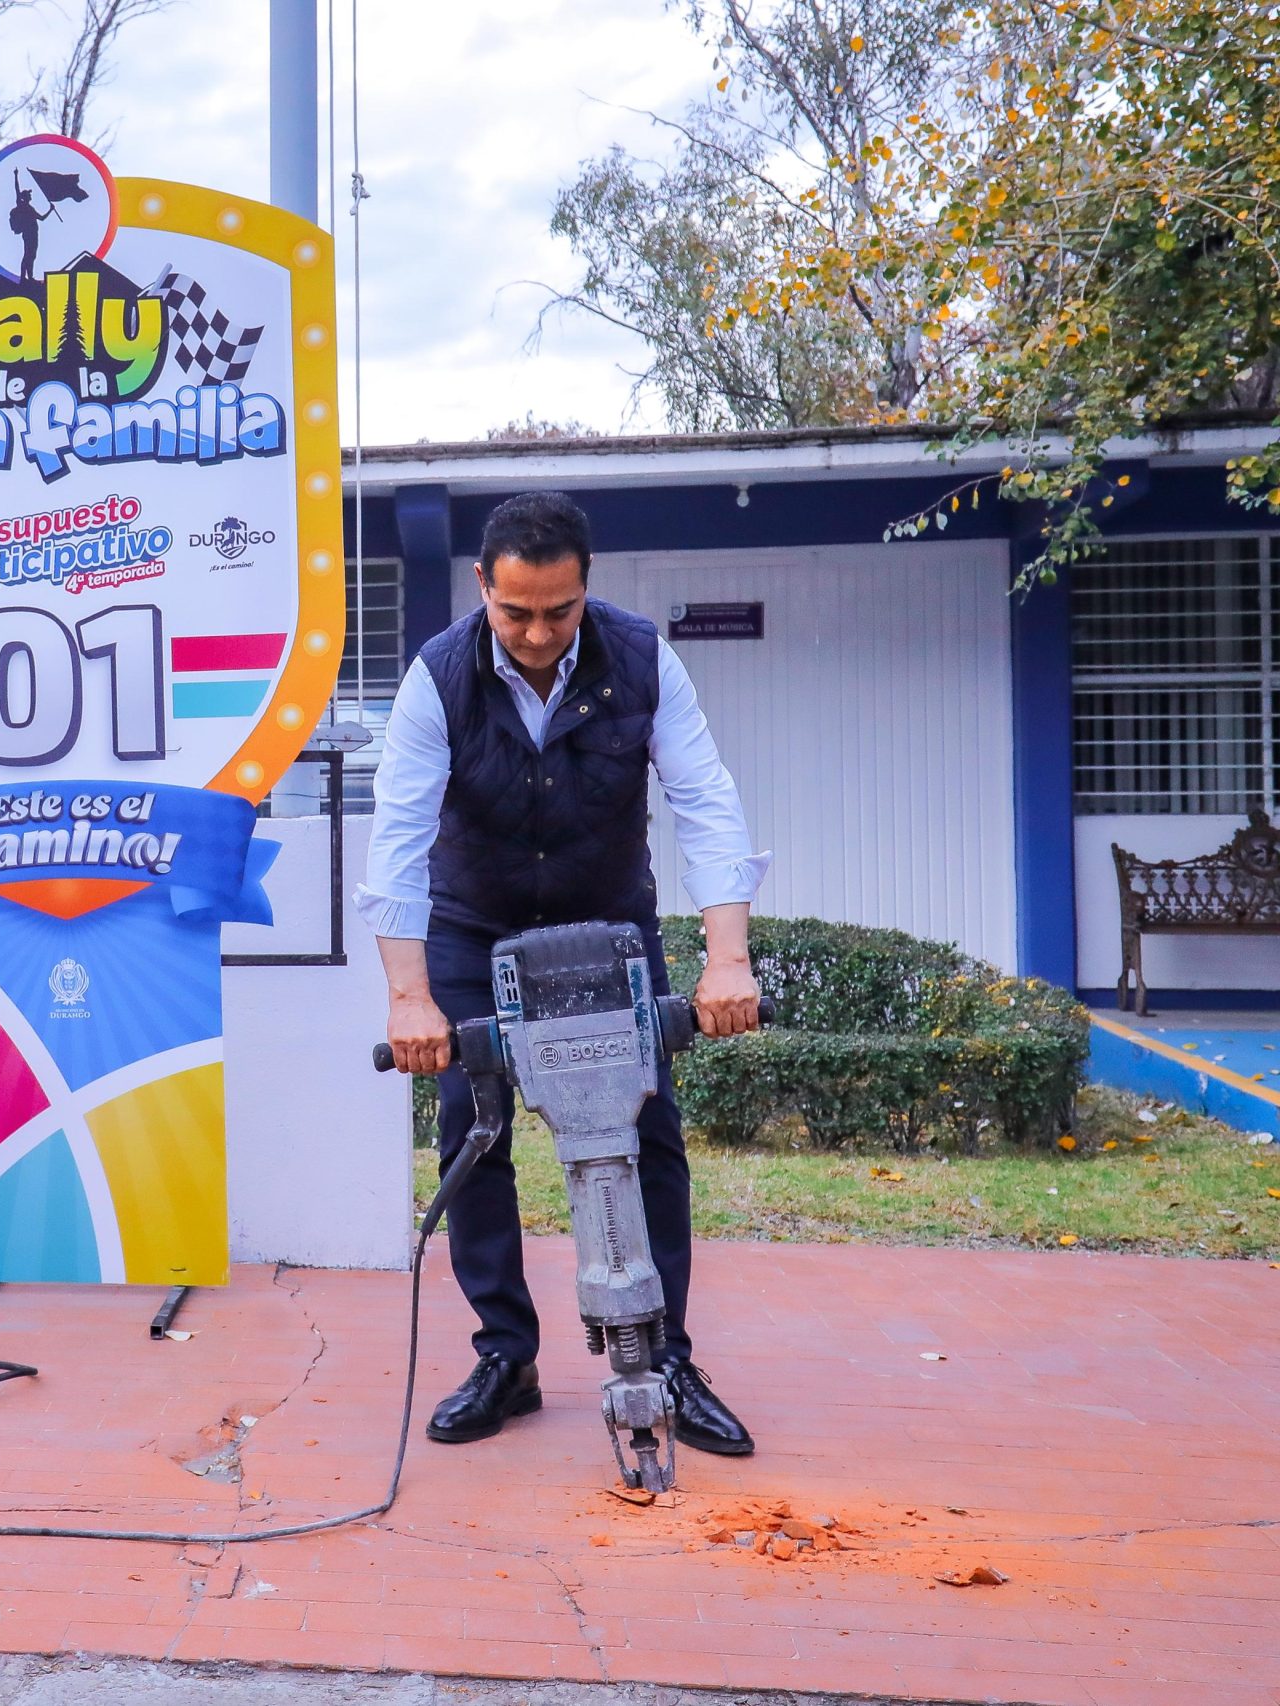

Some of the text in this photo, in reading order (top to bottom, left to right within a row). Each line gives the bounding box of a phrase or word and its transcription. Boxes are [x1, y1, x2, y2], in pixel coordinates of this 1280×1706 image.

[80, 367, 108, 398] la
[88, 561, 164, 588] temporada
[678, 624, 701, 633] SALA
[704, 624, 716, 632] DE
[71, 794, 112, 820] es
[116, 791, 156, 823] el
[568, 1039, 631, 1062] BOSCH
